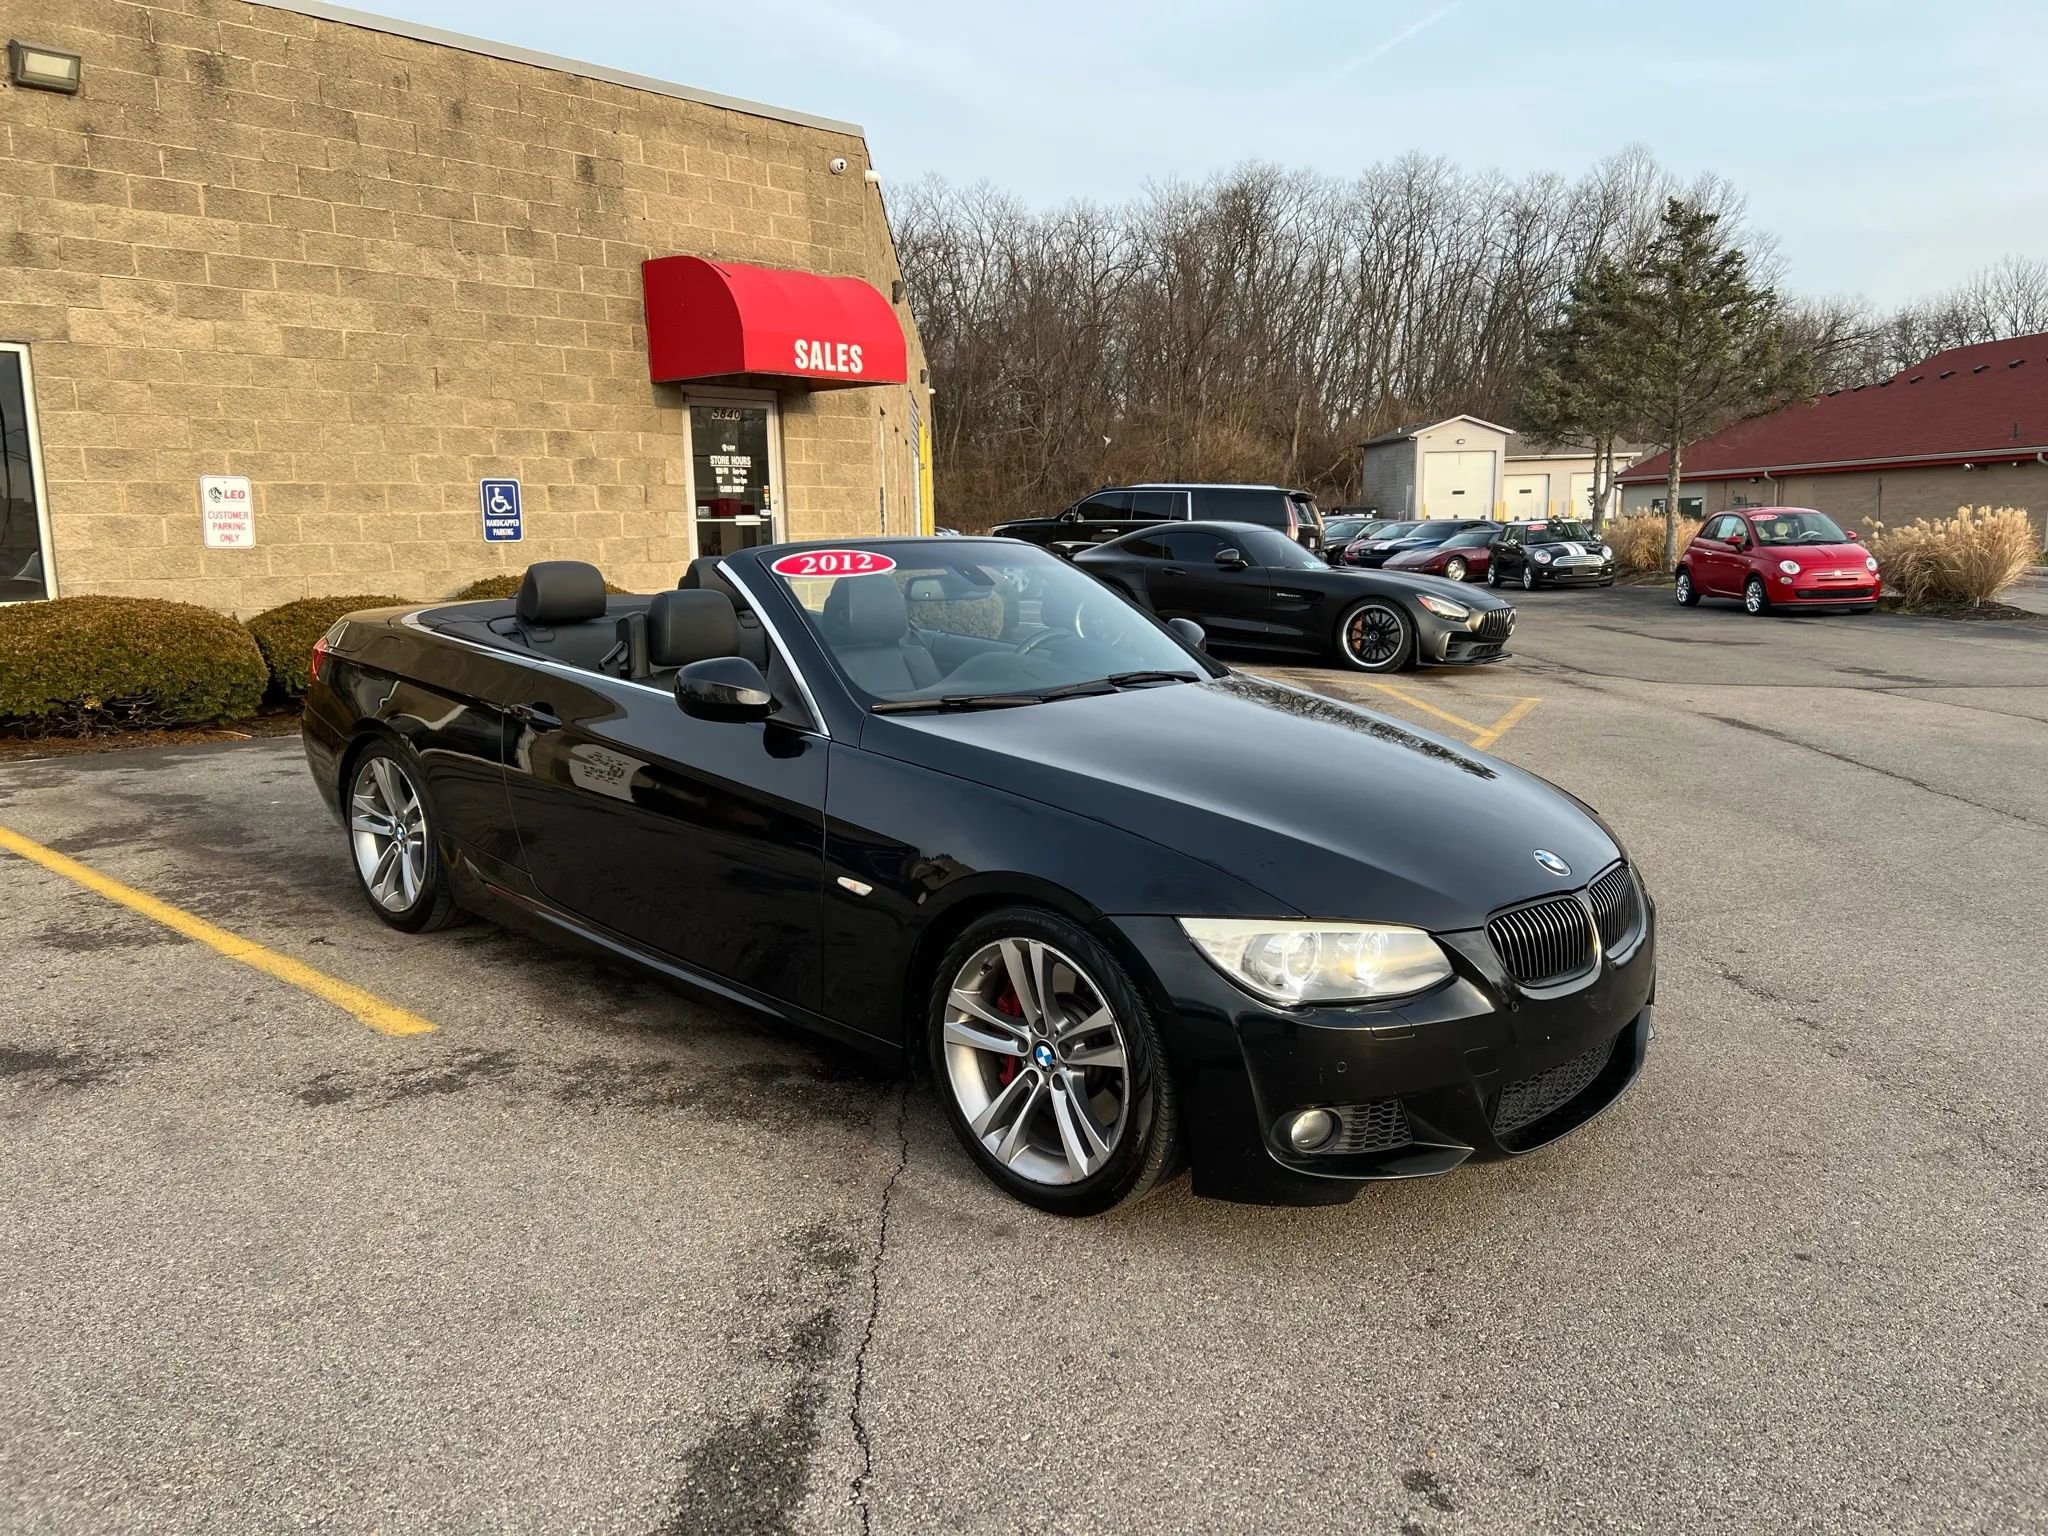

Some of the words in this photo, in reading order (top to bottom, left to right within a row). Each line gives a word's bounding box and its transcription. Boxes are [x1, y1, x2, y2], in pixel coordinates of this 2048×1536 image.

[794, 338, 864, 374] SALES
[712, 408, 741, 419] 5840
[710, 455, 730, 464] STORE
[731, 456, 751, 465] HOURS
[224, 490, 246, 499] LEO
[208, 511, 249, 520] CUSTOMER
[213, 522, 246, 531] PARKING
[486, 519, 520, 527] HANDICAPPED
[493, 528, 515, 536] PARKING
[220, 534, 240, 542] ONLY
[799, 553, 874, 574] 2012
